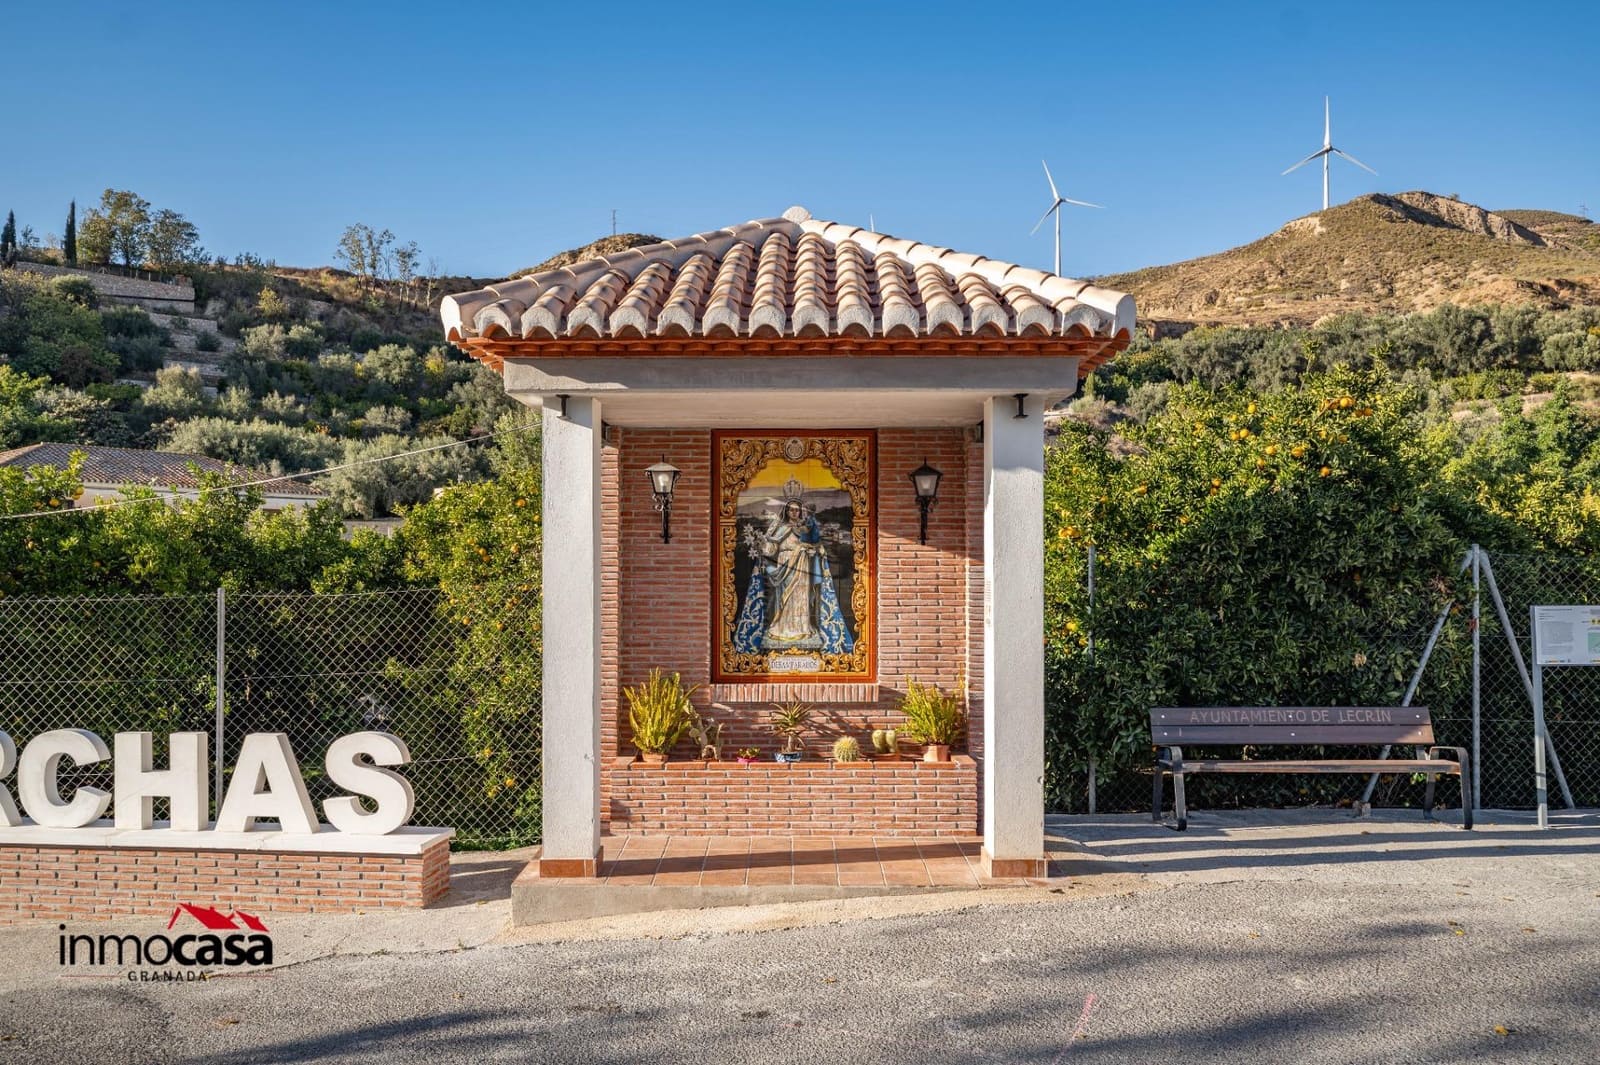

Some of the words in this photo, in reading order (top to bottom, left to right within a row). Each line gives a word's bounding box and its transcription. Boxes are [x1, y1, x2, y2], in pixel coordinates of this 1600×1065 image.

[1190, 709, 1308, 723] AYUNTAMIENTO
[1311, 709, 1330, 723] DE
[0, 728, 415, 836] CHAS
